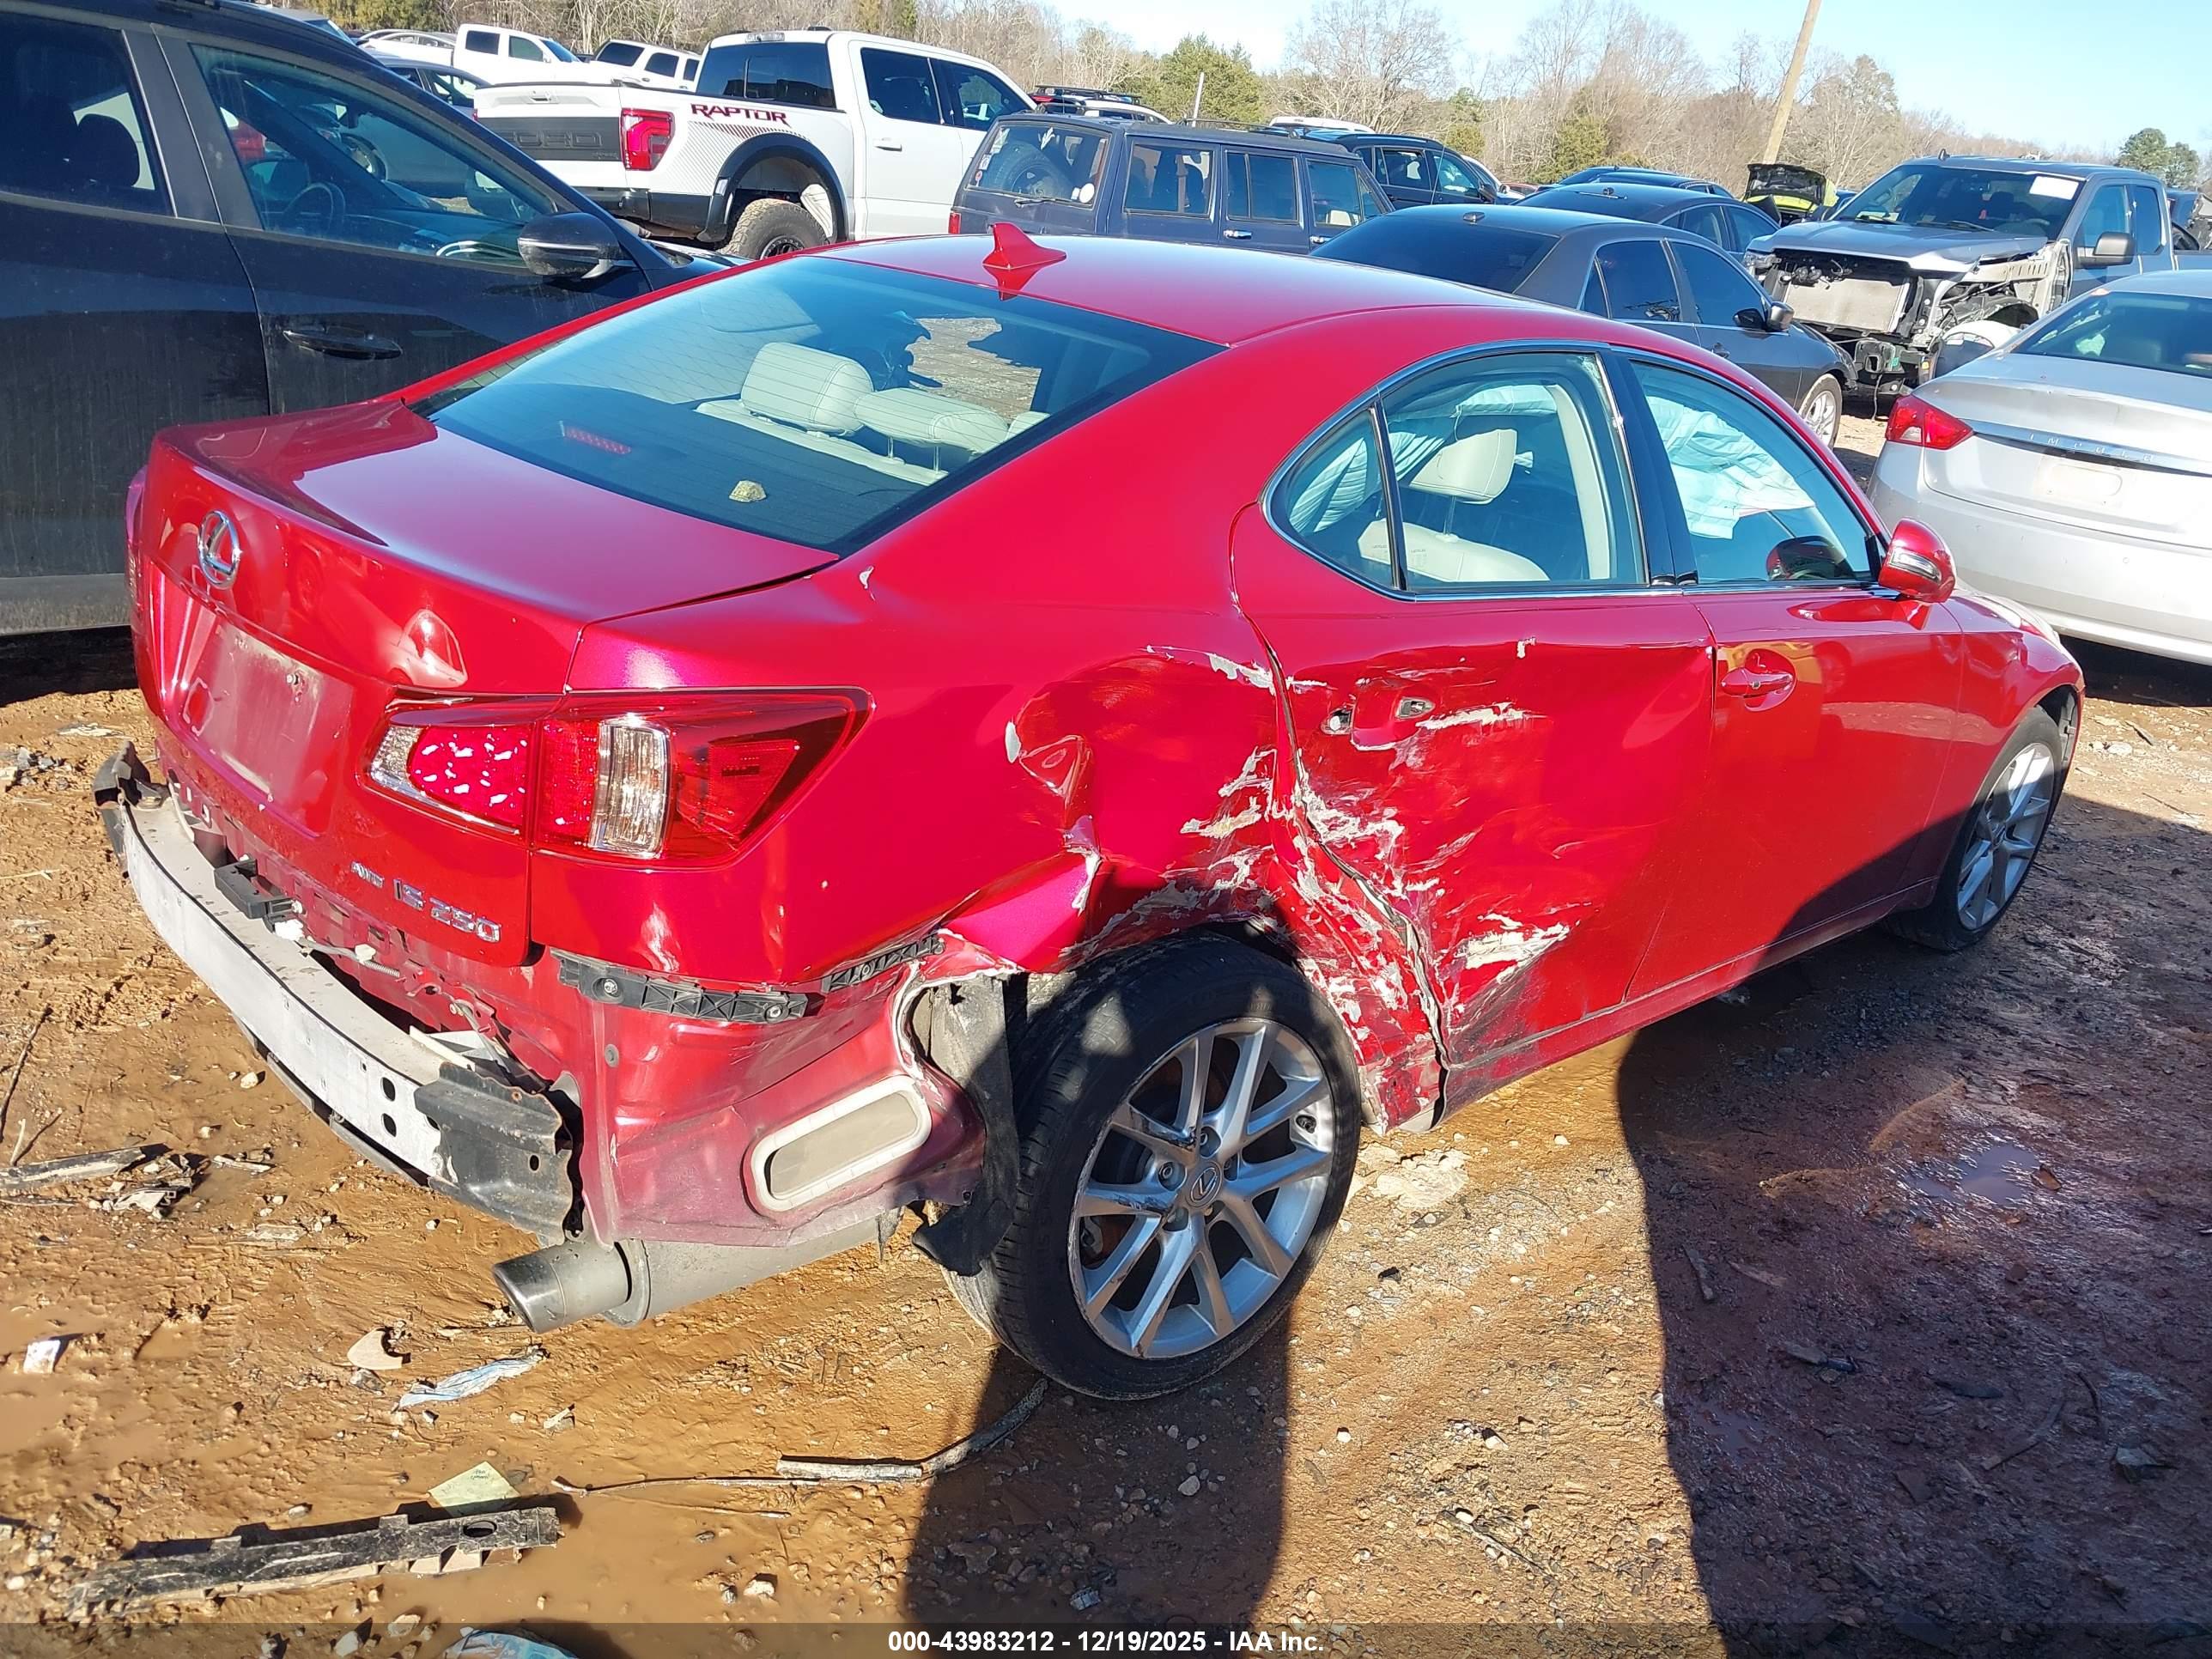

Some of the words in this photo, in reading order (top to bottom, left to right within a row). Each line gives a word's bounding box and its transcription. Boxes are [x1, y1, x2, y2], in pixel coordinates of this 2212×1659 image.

[690, 103, 792, 128] RAPTOR
[393, 878, 424, 911] IS
[429, 896, 502, 943] 250
